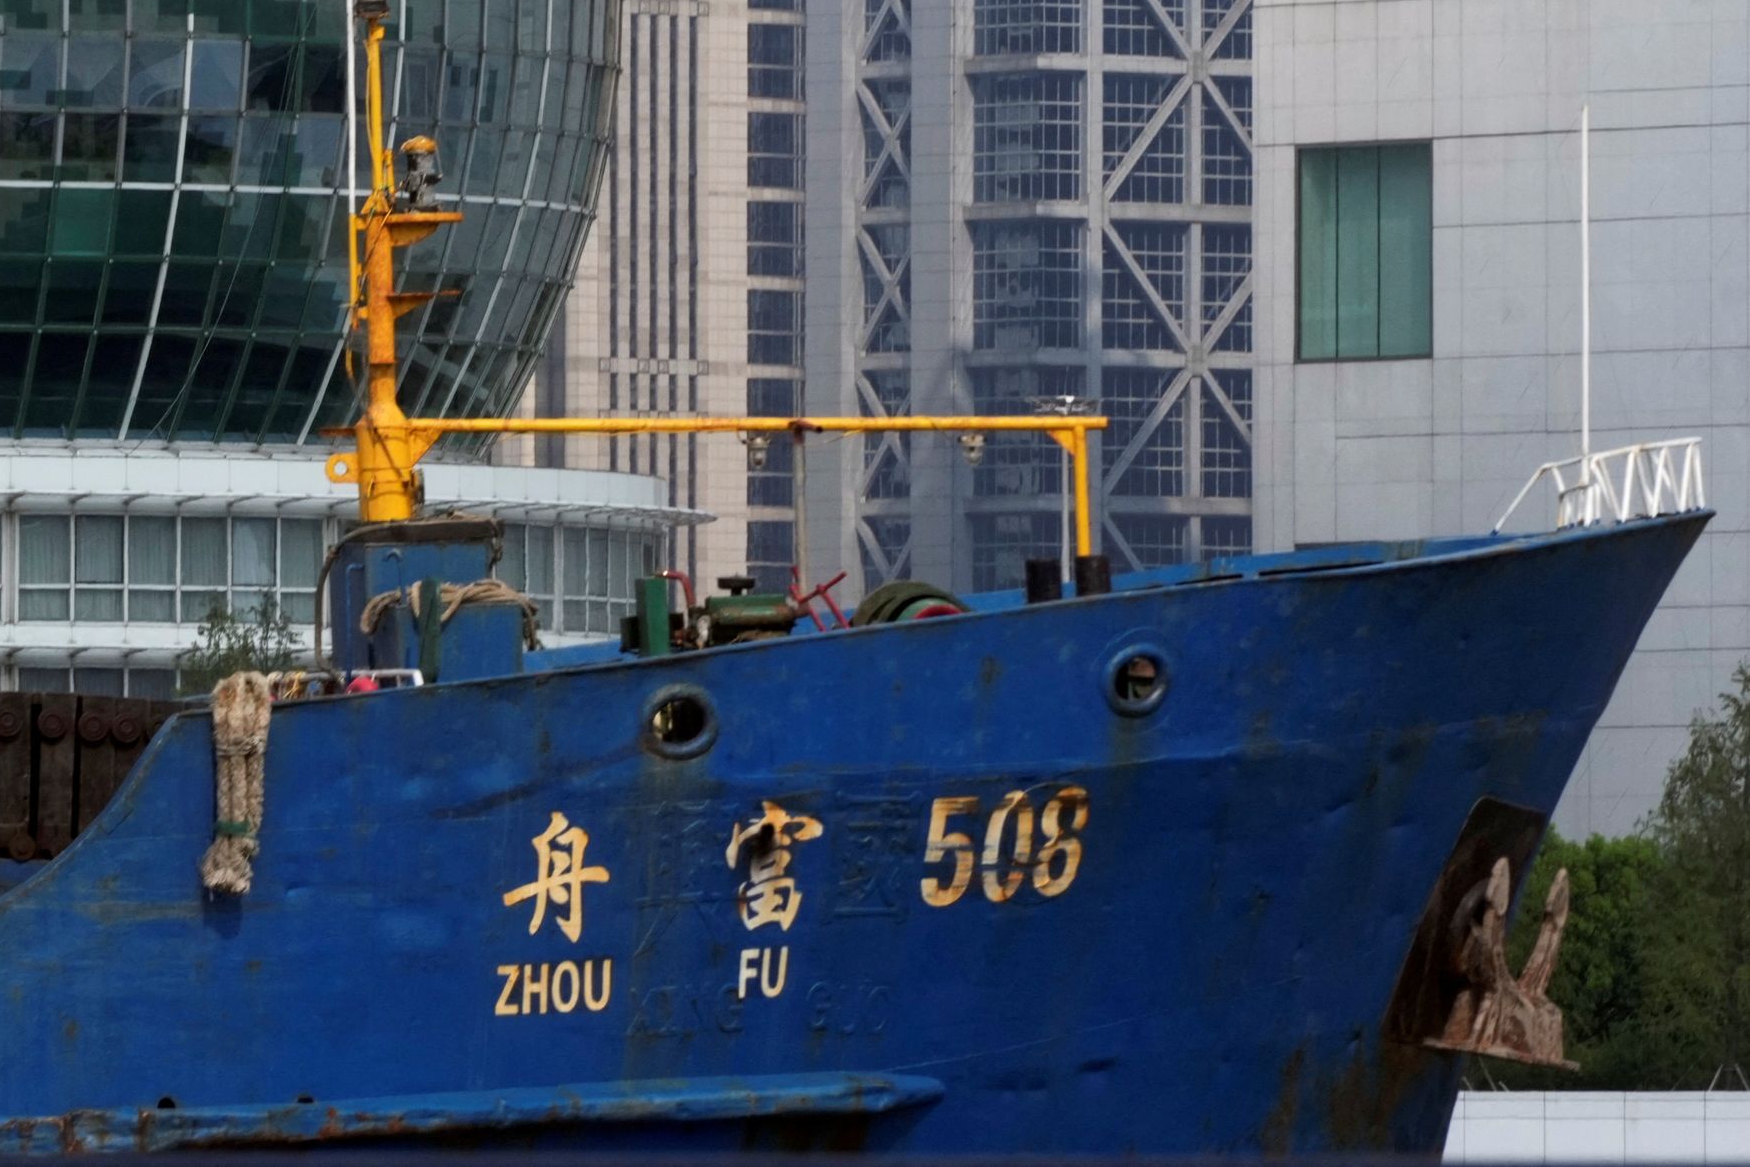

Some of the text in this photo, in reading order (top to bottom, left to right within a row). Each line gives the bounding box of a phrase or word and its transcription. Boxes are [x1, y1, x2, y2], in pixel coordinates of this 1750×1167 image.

[920, 784, 1089, 908] 508
[494, 959, 612, 1017] ZHOU
[737, 946, 789, 999] FU
